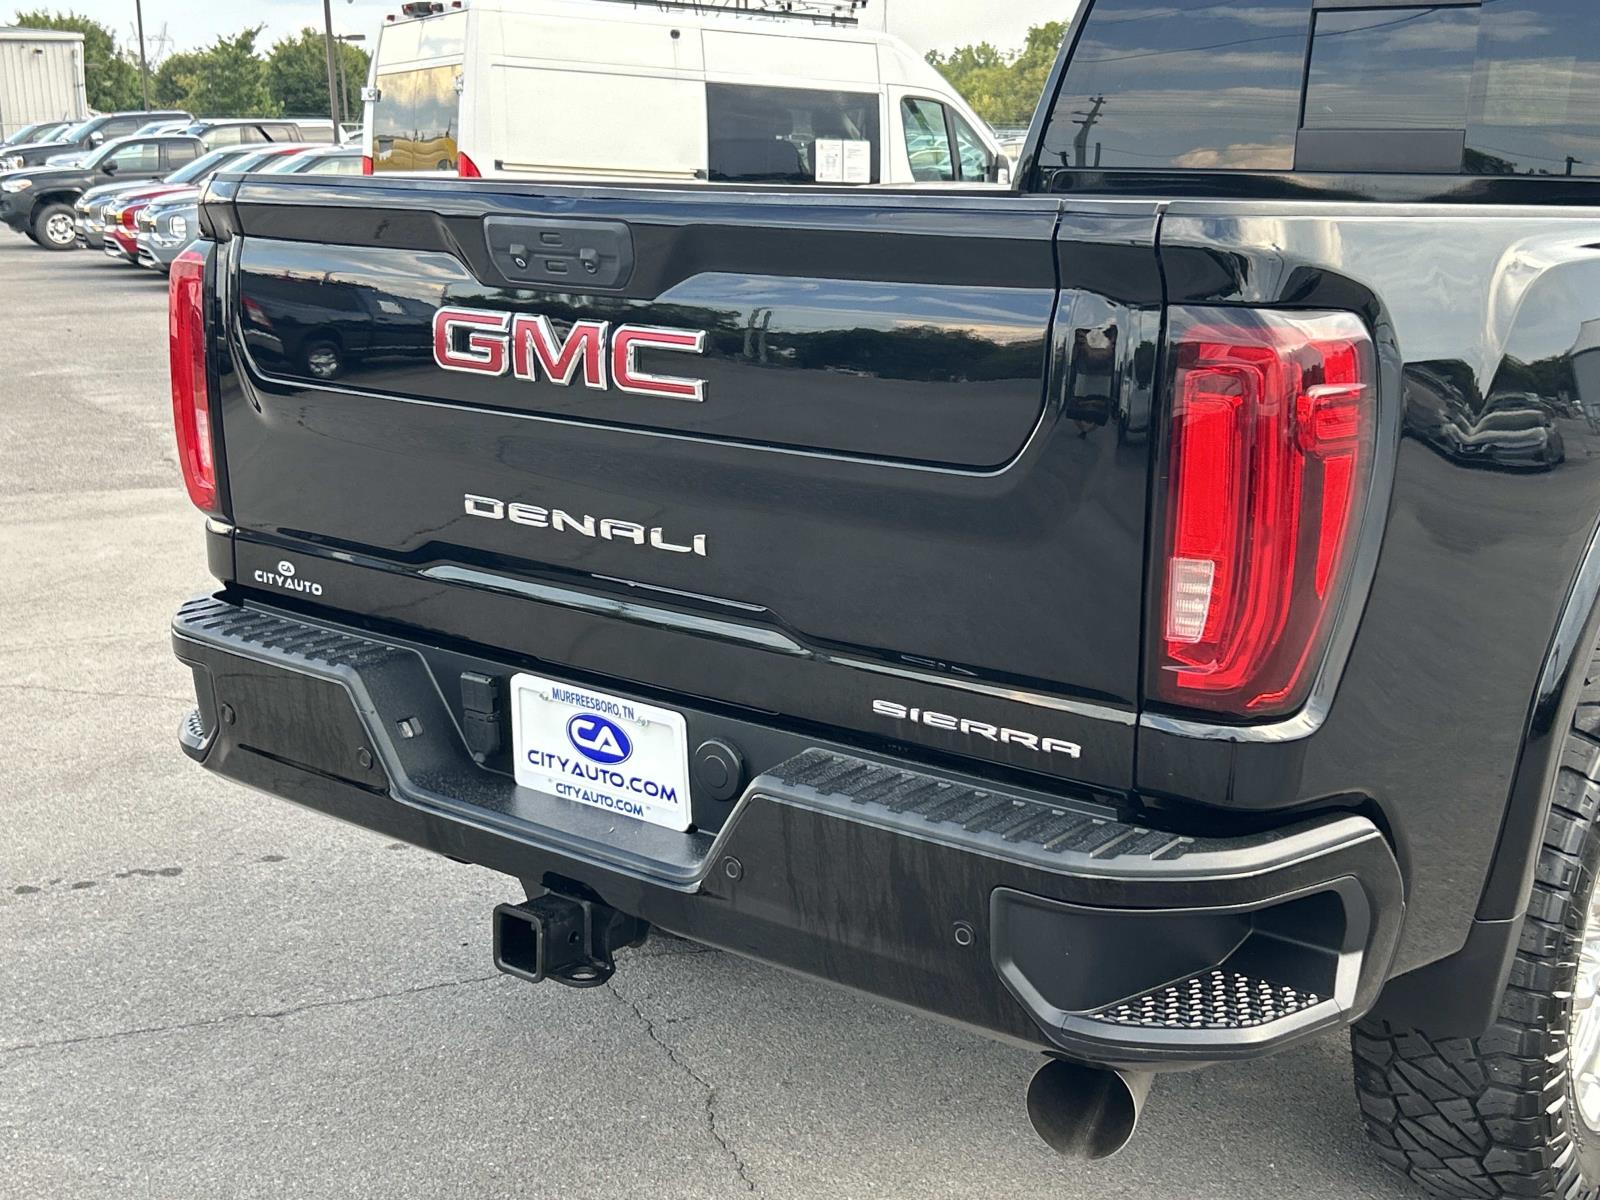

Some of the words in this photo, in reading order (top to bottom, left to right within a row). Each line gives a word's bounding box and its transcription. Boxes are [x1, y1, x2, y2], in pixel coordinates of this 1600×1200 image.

[432, 306, 706, 402] GMC
[464, 493, 707, 556] DENALI
[254, 569, 323, 596] CITYAUTO
[552, 687, 622, 718] MURFREESBORO,
[622, 706, 635, 720] TN
[569, 719, 625, 757] CA
[872, 699, 1082, 758] SIERRA
[528, 749, 678, 803] CITYAUTO.COM
[556, 783, 644, 817] CITYAUTO.COM
